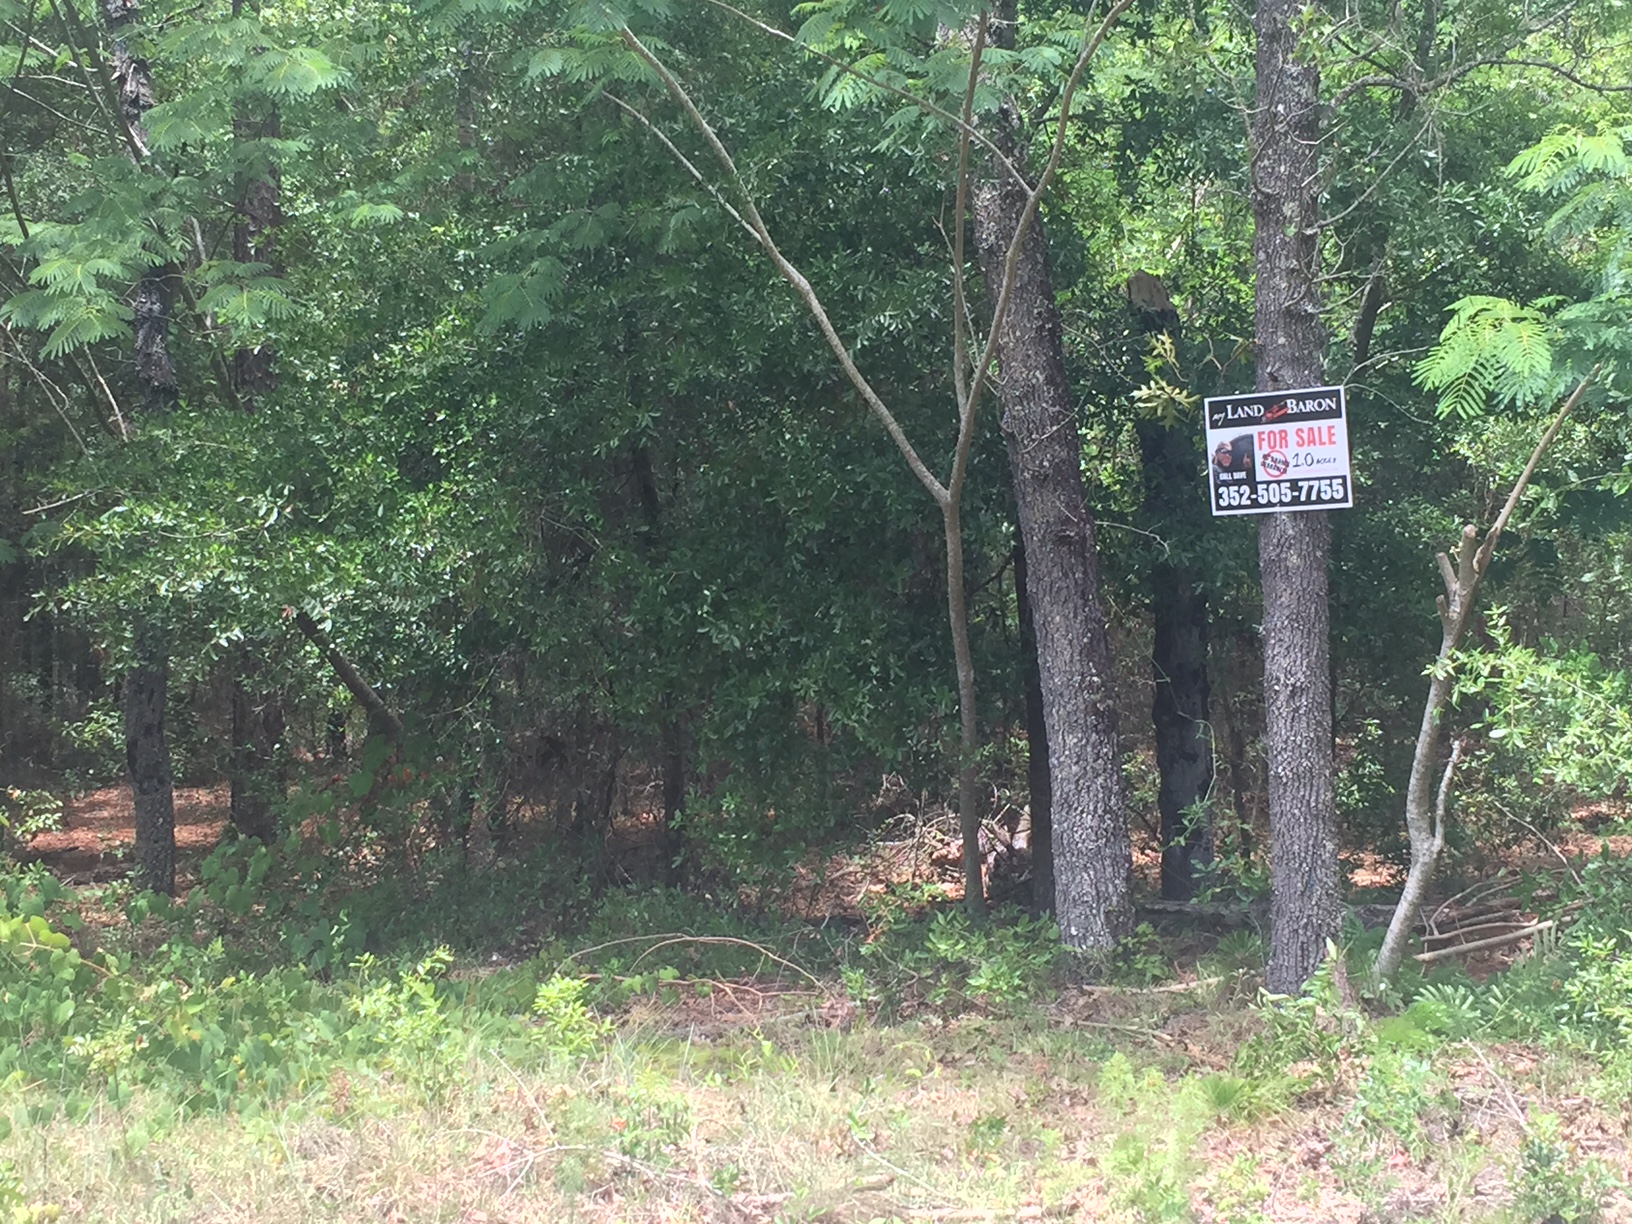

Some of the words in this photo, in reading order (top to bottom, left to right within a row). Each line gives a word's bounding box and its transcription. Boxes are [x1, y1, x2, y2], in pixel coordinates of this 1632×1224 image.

[1226, 404, 1264, 419] LAND
[1286, 398, 1336, 414] BARON
[1257, 429, 1288, 451] FOR
[1295, 425, 1336, 447] SALE
[1292, 452, 1314, 468] 1.0
[1218, 478, 1344, 507] 352-505-7755
